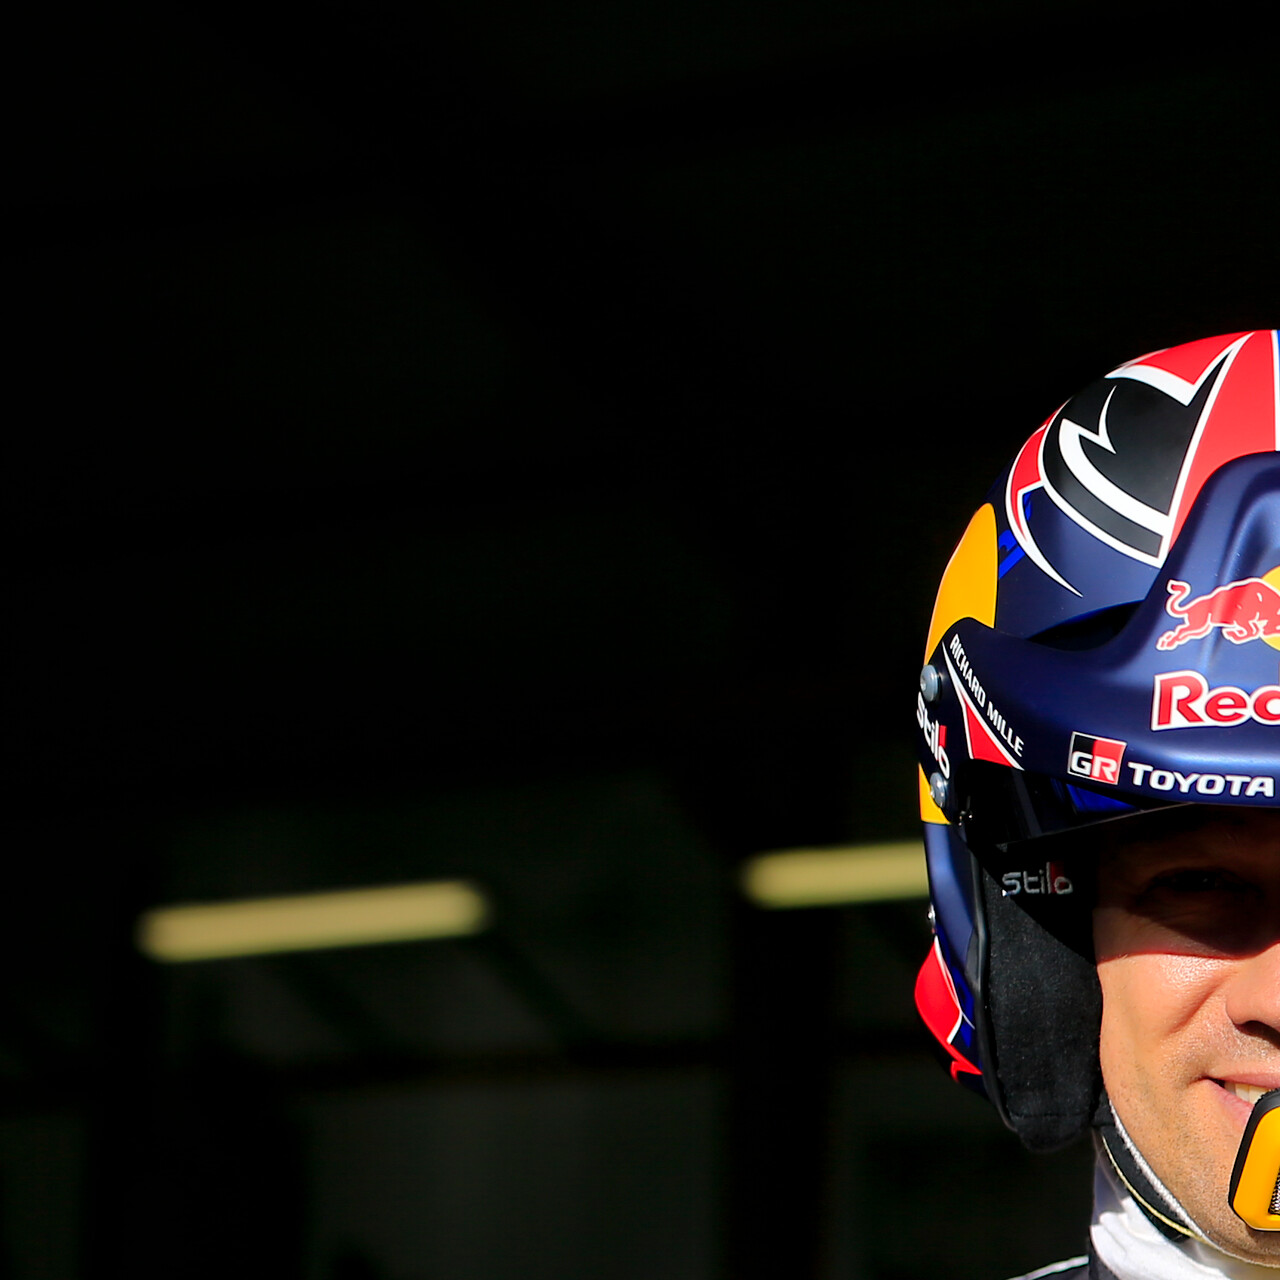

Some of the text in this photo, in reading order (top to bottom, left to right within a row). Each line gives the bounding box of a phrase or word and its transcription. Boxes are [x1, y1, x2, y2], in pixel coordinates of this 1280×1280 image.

[949, 633, 1025, 758] RICHARD MILLE
[916, 691, 950, 779] Stilo
[1127, 762, 1275, 798] TOYOTA
[1001, 861, 1074, 897] Stilo
